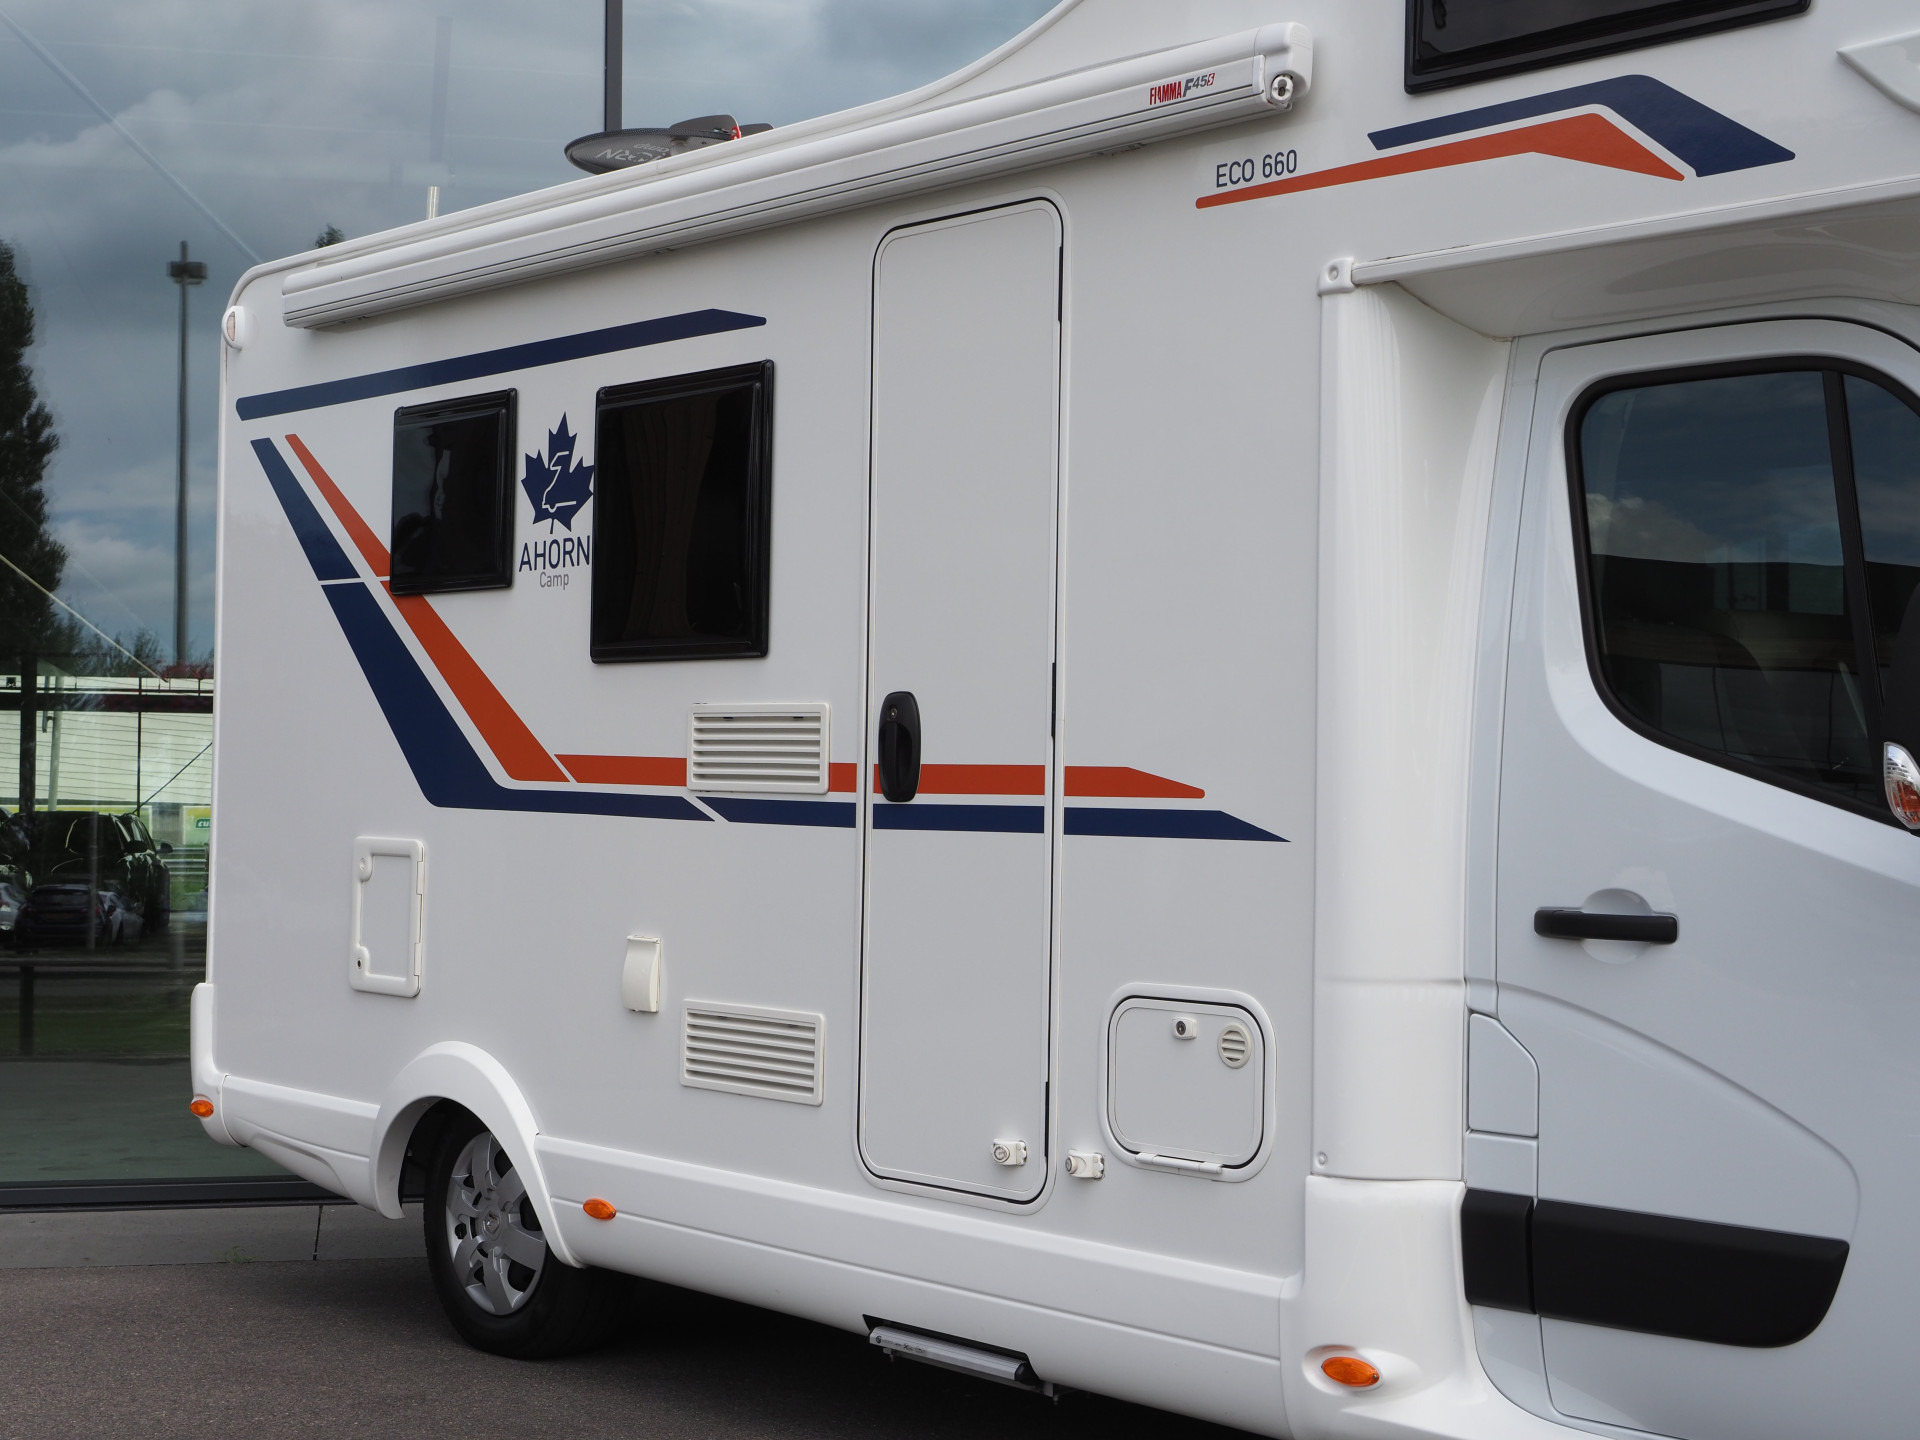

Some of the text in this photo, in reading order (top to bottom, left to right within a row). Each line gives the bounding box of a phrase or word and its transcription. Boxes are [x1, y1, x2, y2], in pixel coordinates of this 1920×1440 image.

[1149, 80, 1182, 106] FIAMMA
[1215, 149, 1298, 188] ECO 660
[518, 534, 591, 573] AHORN
[539, 571, 570, 591] Camp
